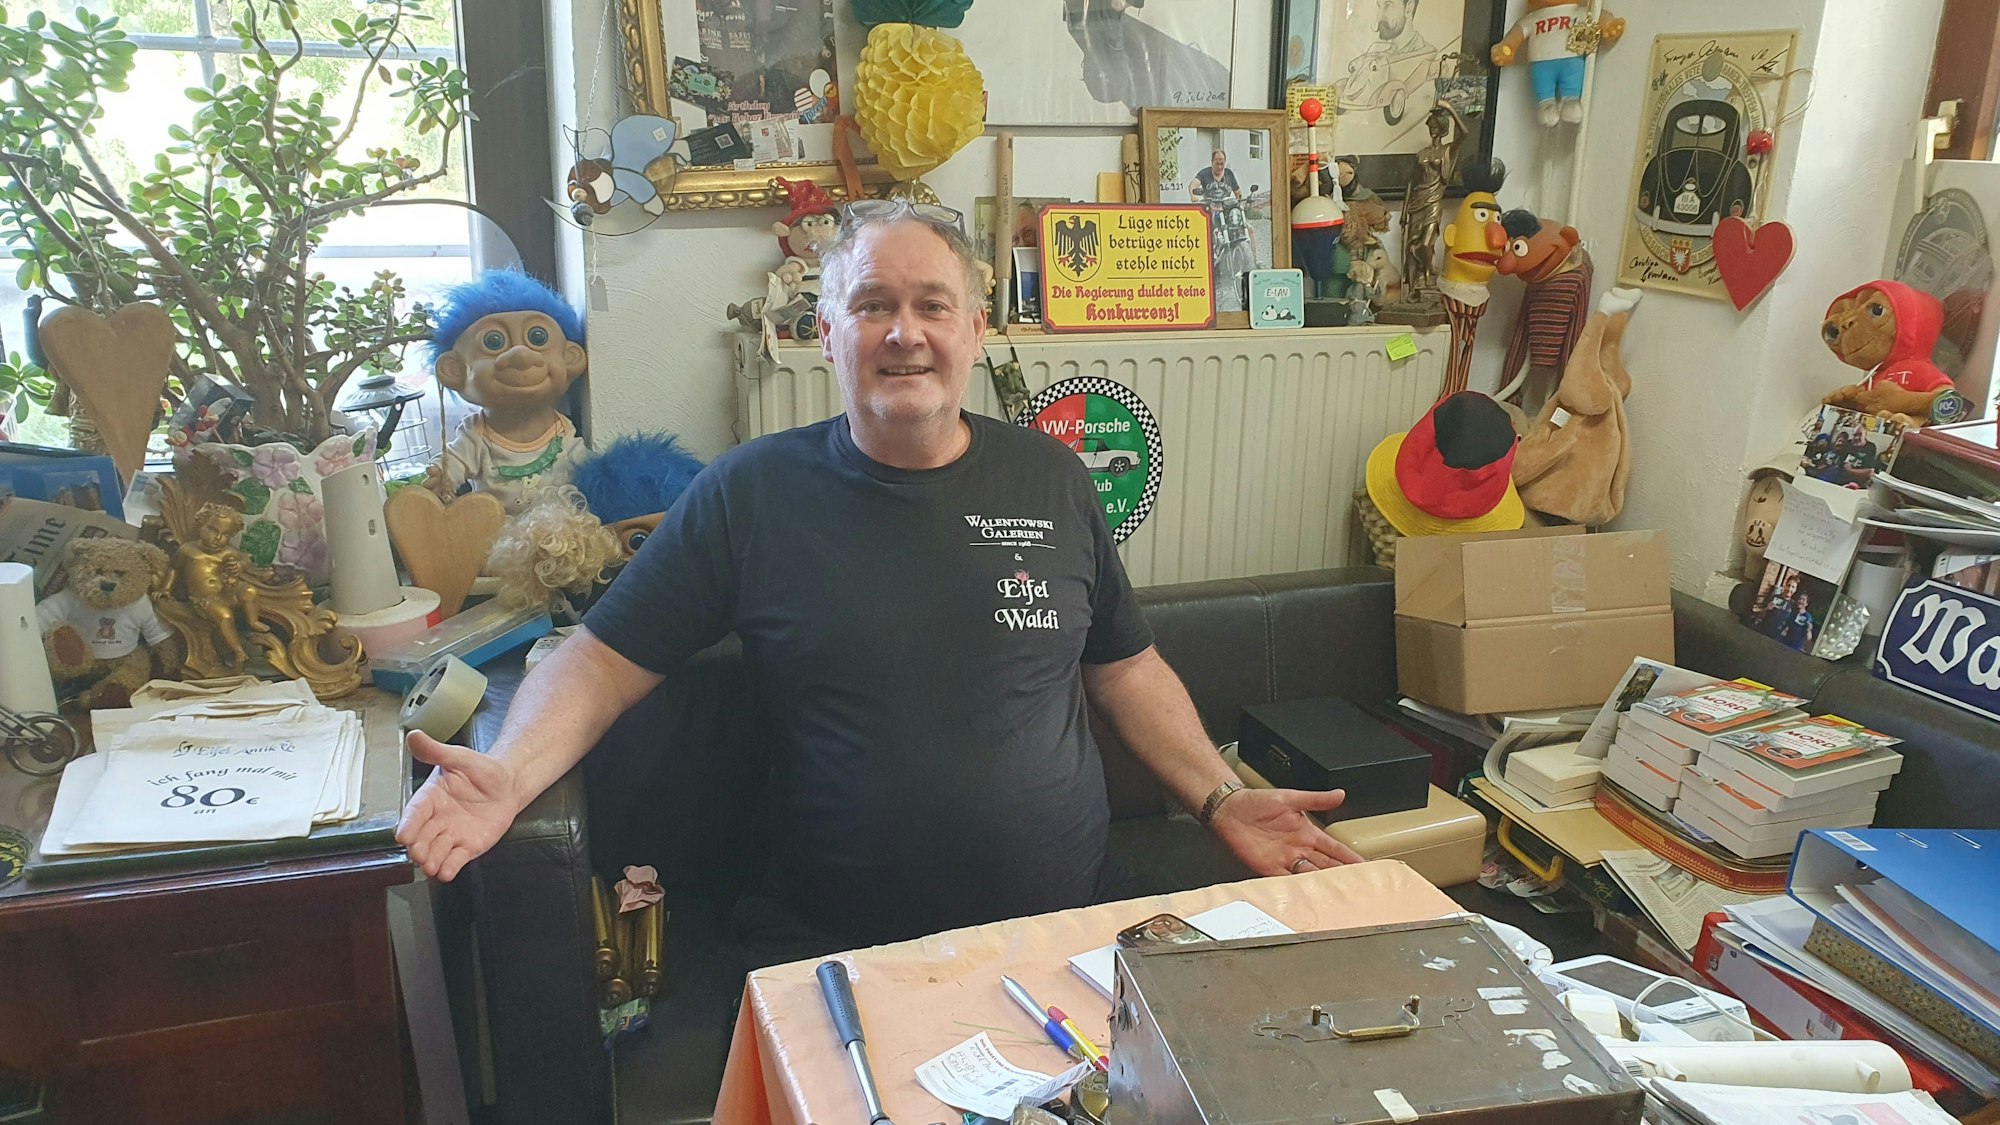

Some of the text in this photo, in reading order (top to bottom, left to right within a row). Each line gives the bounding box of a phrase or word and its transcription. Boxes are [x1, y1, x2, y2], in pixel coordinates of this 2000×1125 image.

[1118, 214, 1190, 233] Lüge nicht
[1109, 234, 1201, 253] betrüge nicht
[1116, 255, 1196, 274] stehle nicht
[1051, 283, 1206, 301] Die Regierung duldet keine
[1041, 418, 1131, 436] VW-Porsche
[1106, 498, 1130, 514] e.V.
[964, 515, 1055, 531] WALENTOWSKI
[981, 527, 1044, 540] GALERIEN
[1014, 553, 1024, 561] &
[996, 578, 1050, 605] Eifel
[994, 608, 1060, 631] Waldi
[1699, 694, 1749, 712] MORD
[1784, 730, 1837, 748] MORD
[147, 766, 300, 787] ich fang mal mit
